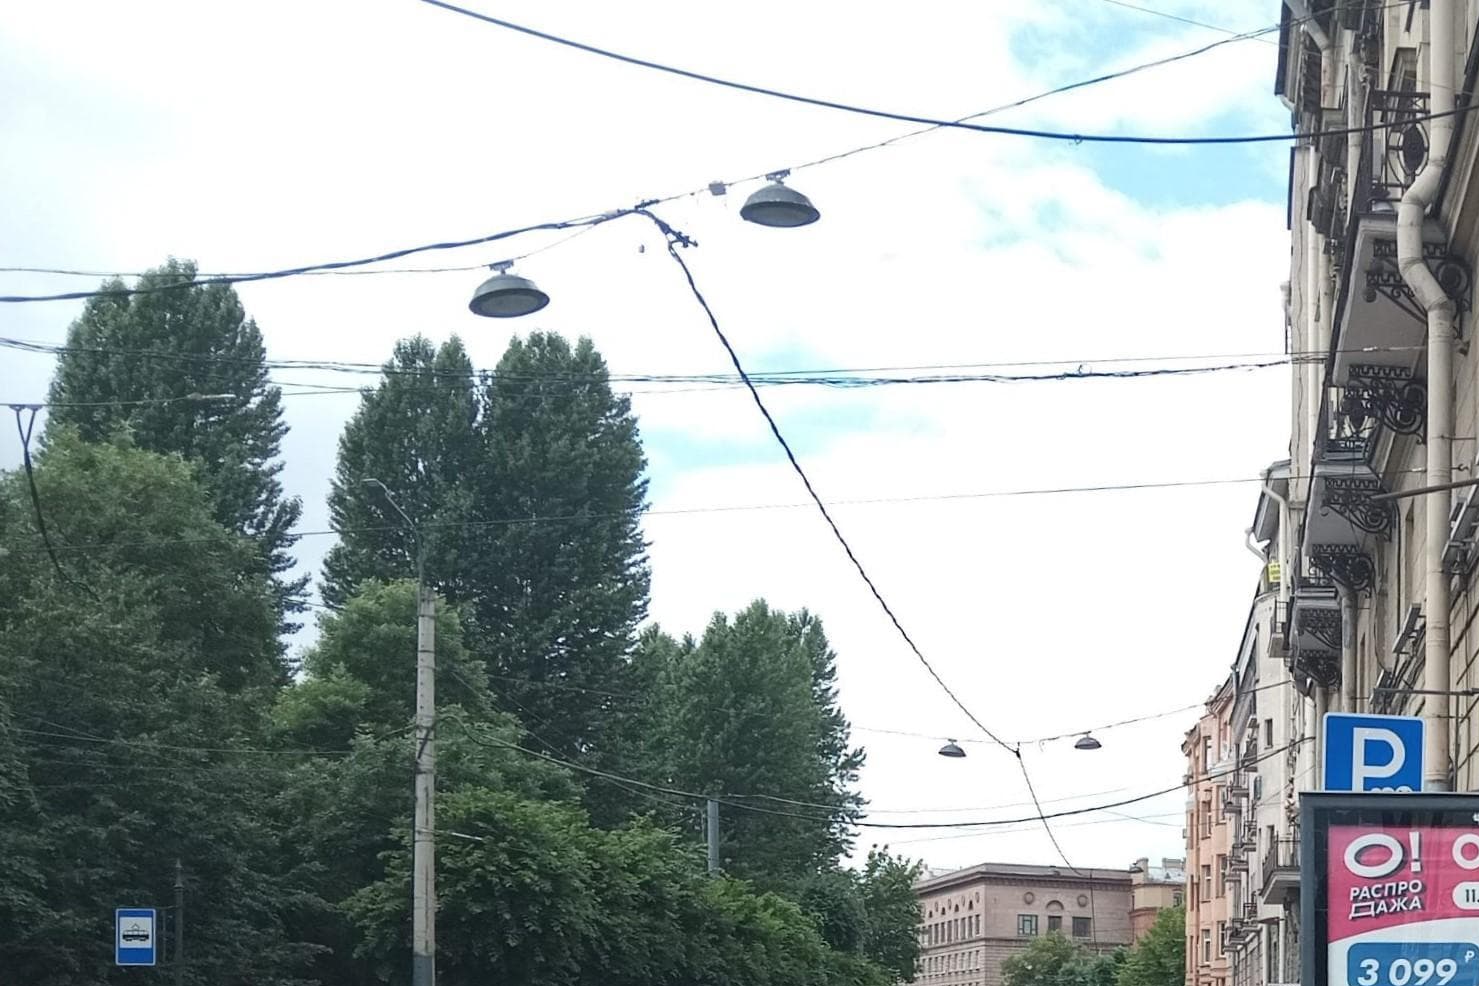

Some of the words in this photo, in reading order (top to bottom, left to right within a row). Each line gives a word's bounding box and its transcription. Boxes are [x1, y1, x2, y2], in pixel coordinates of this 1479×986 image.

[1352, 727, 1406, 793] P
[1350, 879, 1423, 901] РАСПРО
[1348, 897, 1423, 920] ДАЖА
